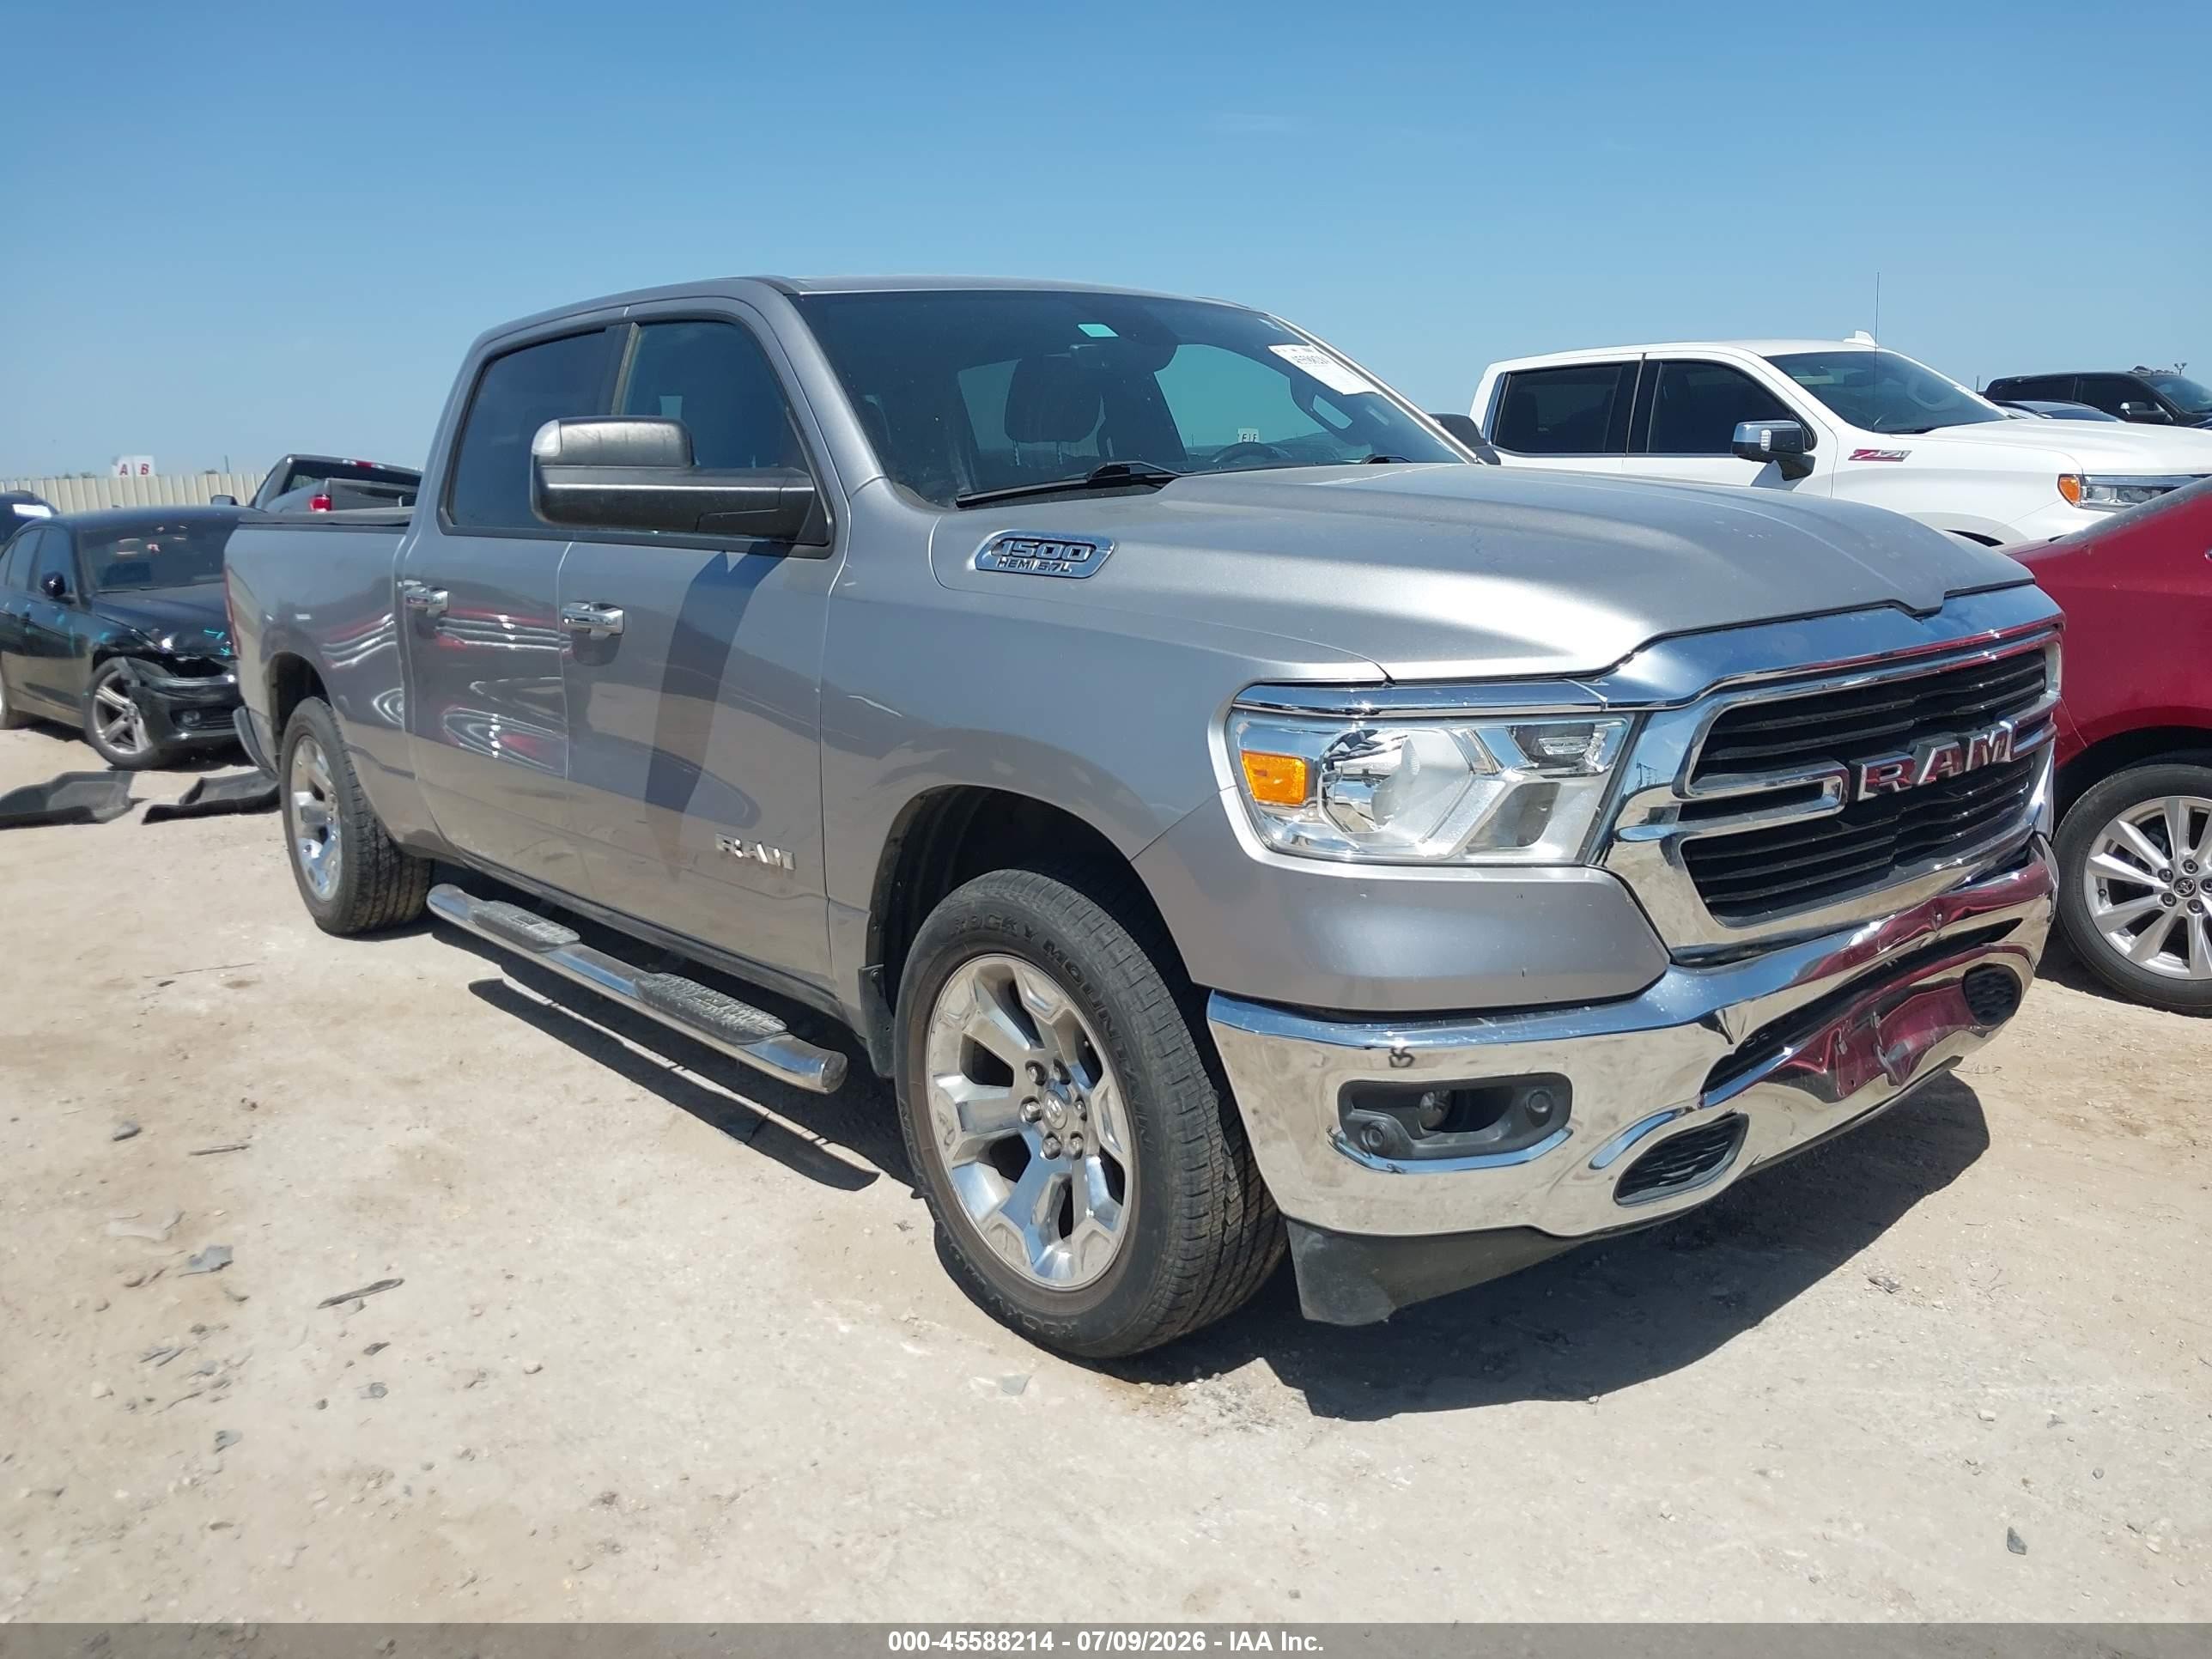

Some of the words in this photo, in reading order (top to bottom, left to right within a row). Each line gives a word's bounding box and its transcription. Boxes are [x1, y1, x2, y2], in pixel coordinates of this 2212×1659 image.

[118, 463, 129, 476] A
[140, 463, 150, 476] B
[996, 539, 1092, 562] 1500
[997, 558, 1034, 571] HEMI
[1036, 561, 1073, 573] 5.7L
[1853, 726, 2014, 802] RAM
[714, 832, 796, 871] RAM
[950, 912, 1039, 945] ROCKY
